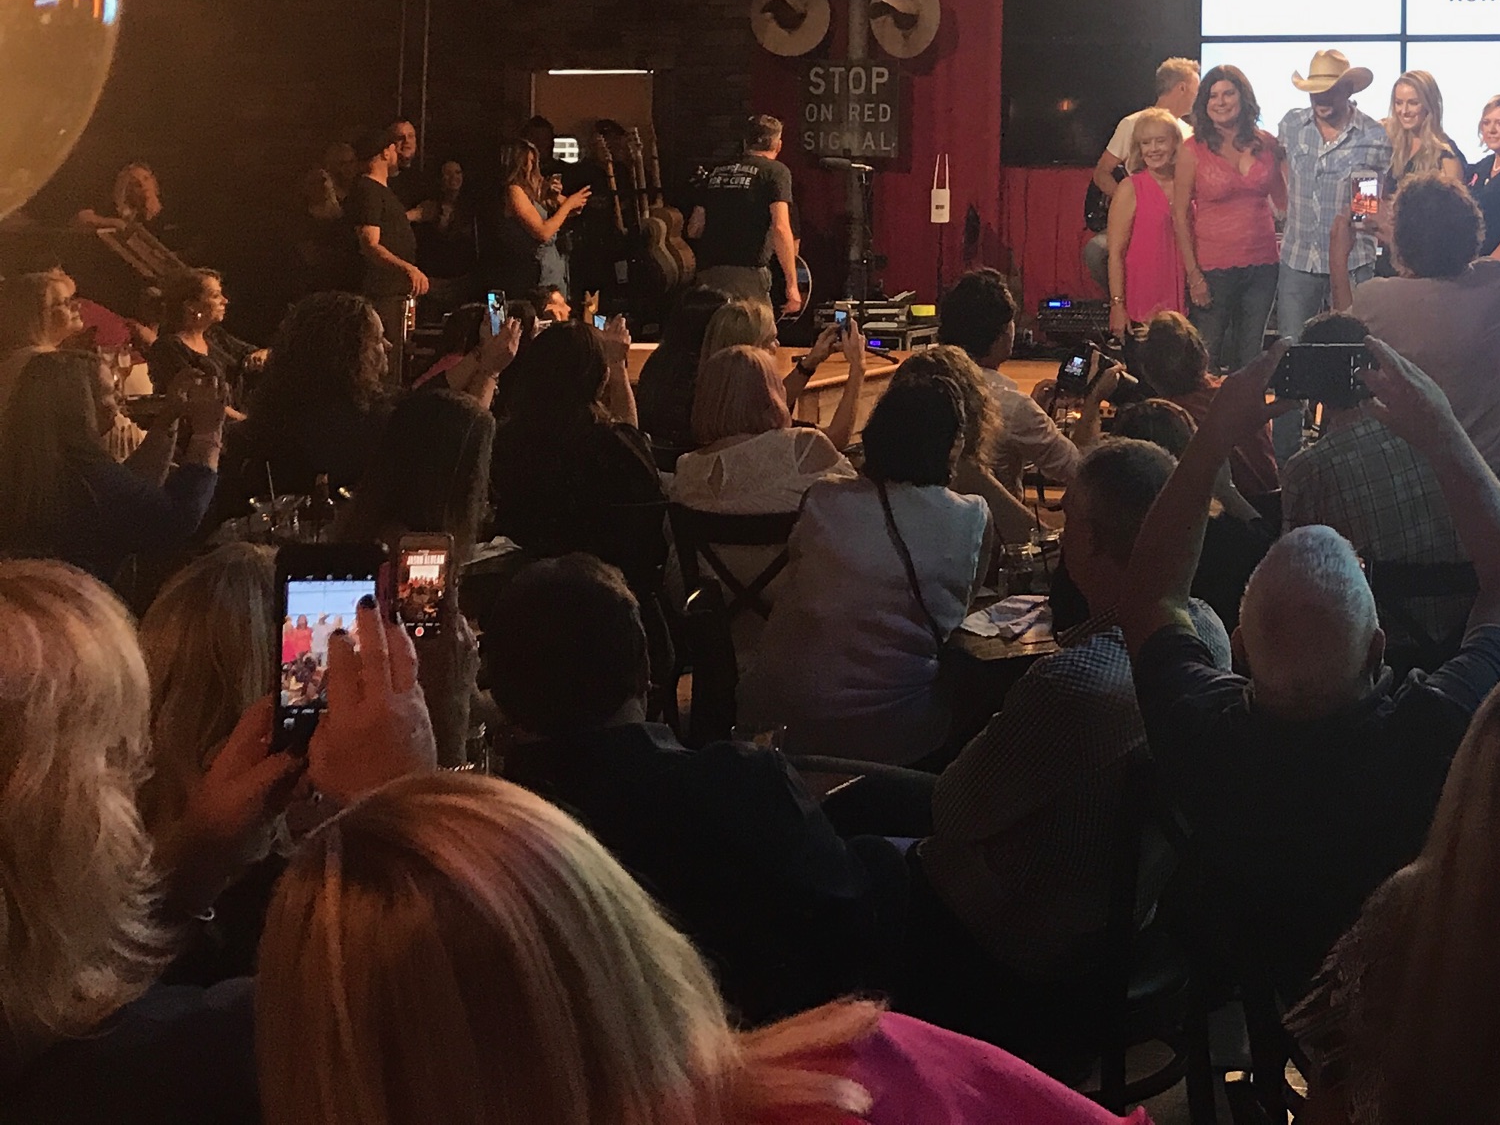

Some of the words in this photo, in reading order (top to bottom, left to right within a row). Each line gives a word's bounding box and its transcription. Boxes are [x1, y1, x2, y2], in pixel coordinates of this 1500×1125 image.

[808, 66, 889, 95] STOP
[805, 103, 833, 123] ON
[848, 103, 891, 123] RED
